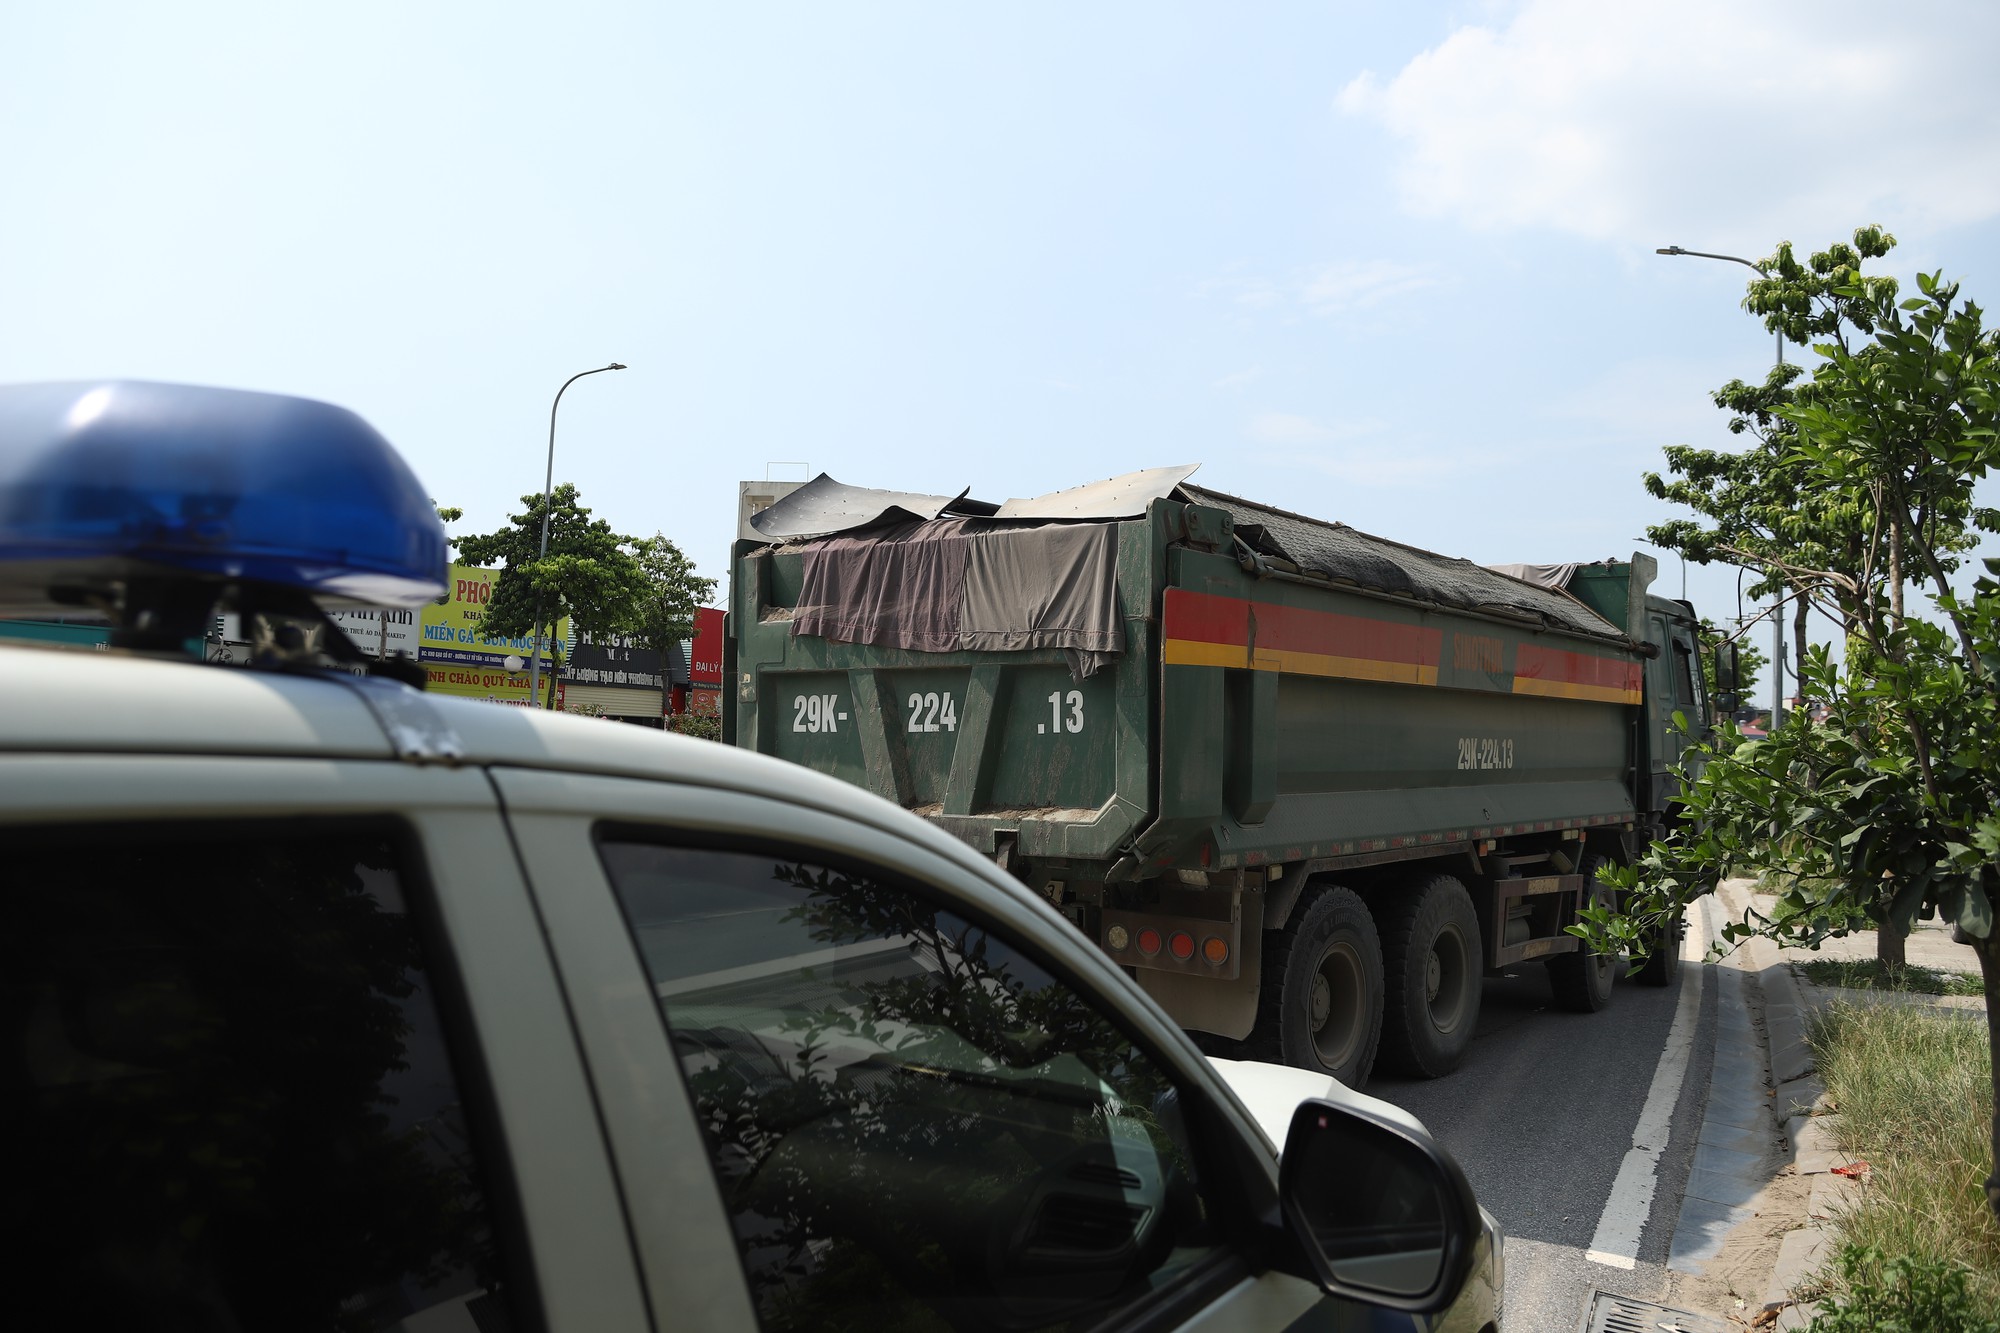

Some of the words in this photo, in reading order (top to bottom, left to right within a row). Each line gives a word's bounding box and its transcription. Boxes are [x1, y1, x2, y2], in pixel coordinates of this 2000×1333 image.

[455, 574, 492, 605] PHỞ
[424, 620, 455, 642] MIẾN
[425, 667, 446, 682] ÍNH
[449, 671, 480, 685] CHÀO
[483, 673, 506, 688] QUÝ
[508, 676, 545, 689] KHÁH
[792, 694, 848, 733] 29K-
[907, 692, 957, 733] 224
[1037, 690, 1084, 734] .13
[1457, 738, 1513, 770] 29K-224.13
